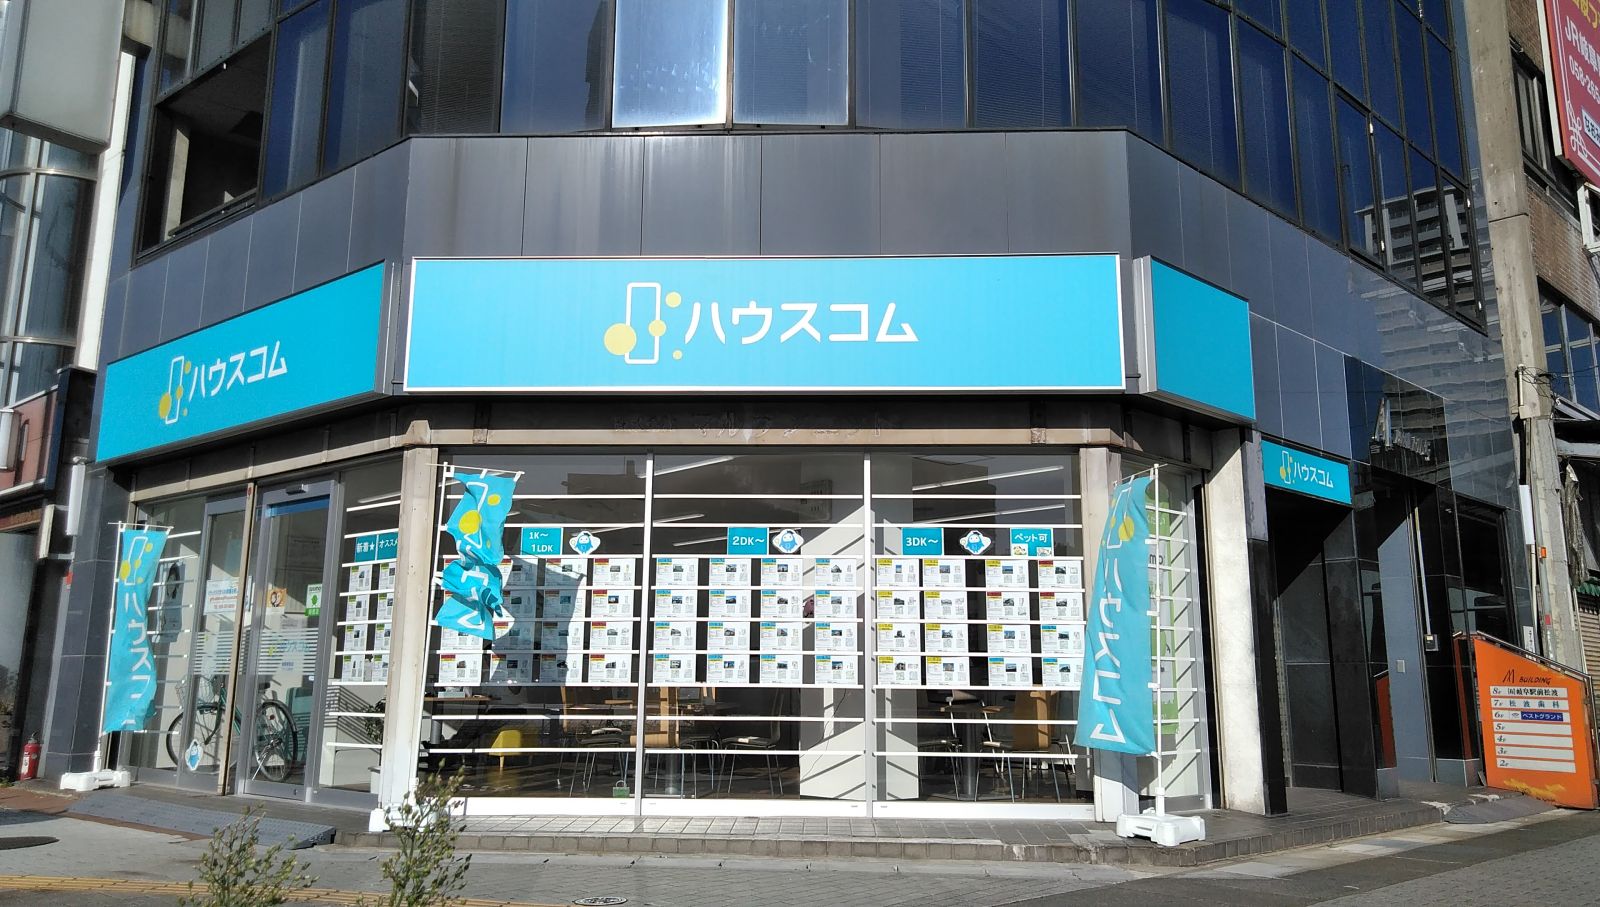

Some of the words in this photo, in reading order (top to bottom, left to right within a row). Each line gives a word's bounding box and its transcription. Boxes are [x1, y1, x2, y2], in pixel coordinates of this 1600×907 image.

[685, 300, 919, 345] ハウスコム
[188, 340, 288, 402] ハウスコム
[1293, 462, 1334, 489] ハウスコム
[1014, 533, 1048, 543] ペット可
[531, 543, 553, 552] 1LDK
[1519, 676, 1552, 686] BUILDING
